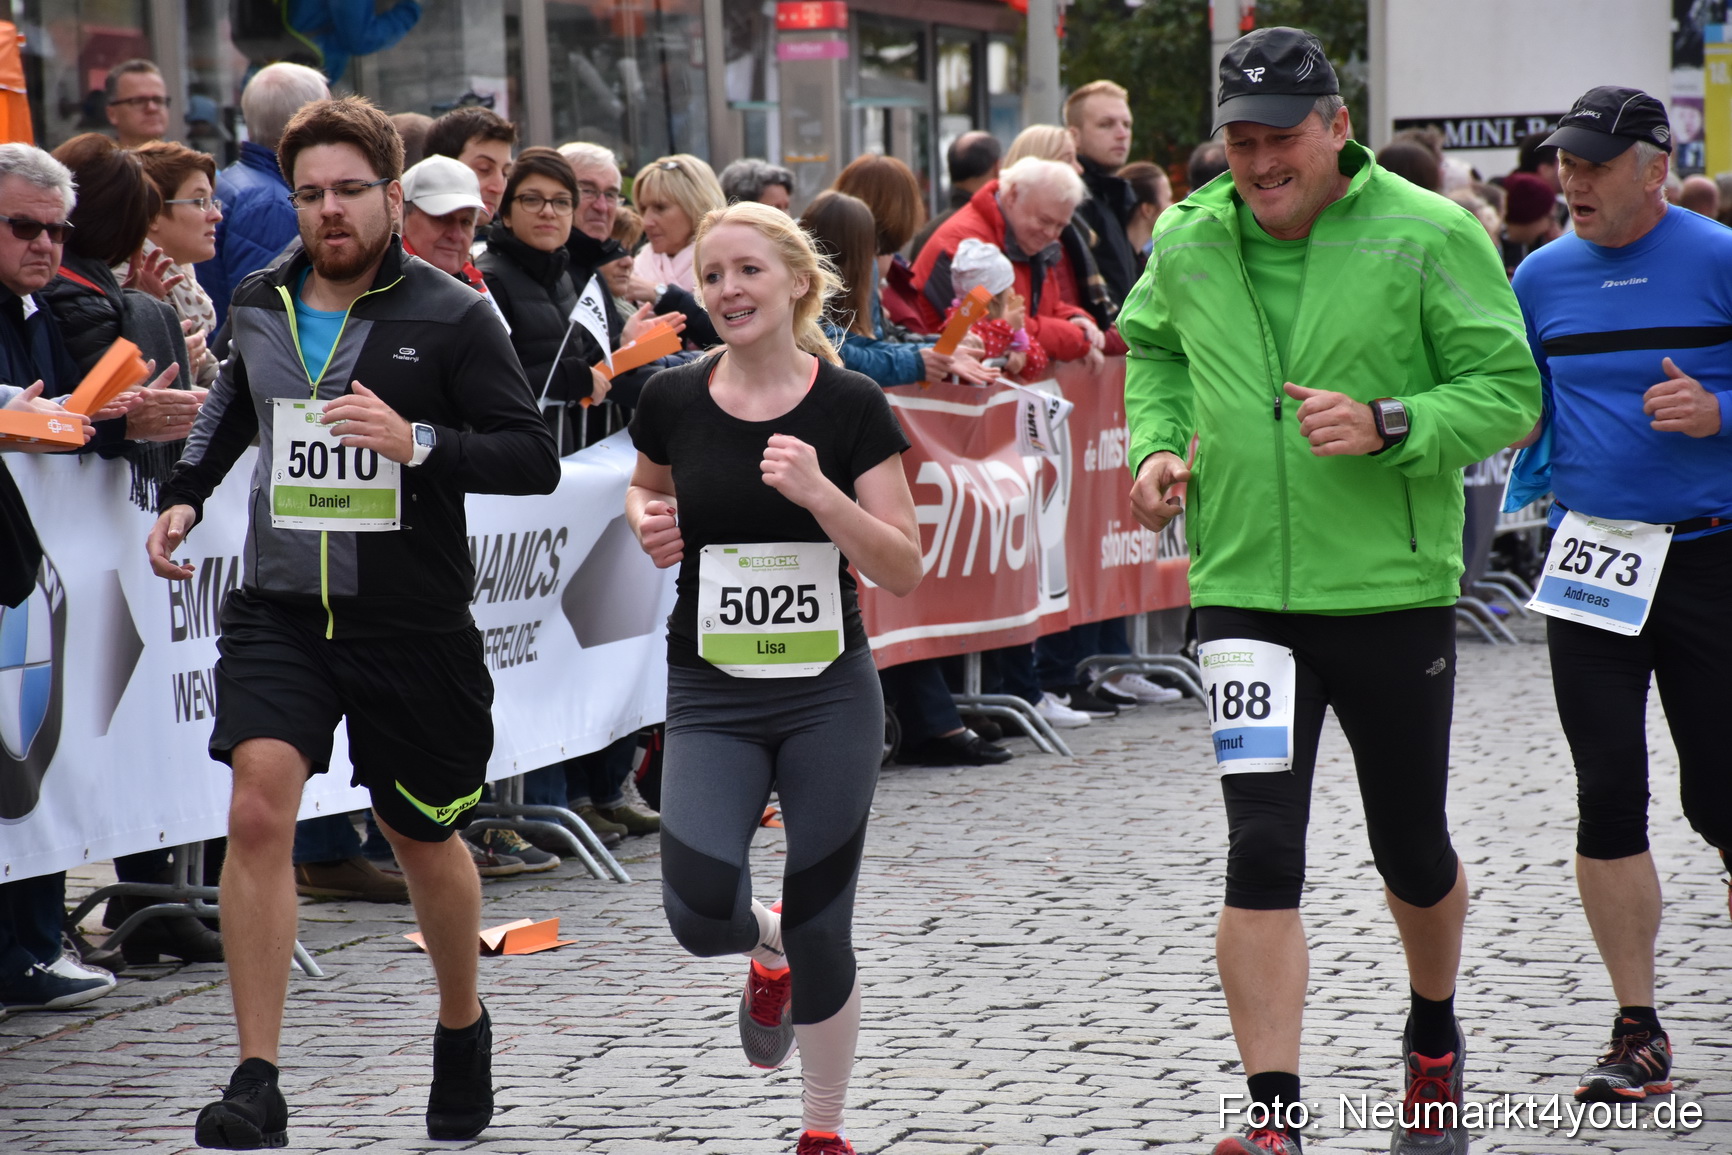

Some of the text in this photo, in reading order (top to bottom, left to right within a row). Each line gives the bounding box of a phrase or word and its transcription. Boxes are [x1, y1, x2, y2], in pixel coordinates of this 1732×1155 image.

[288, 440, 378, 481] 5010
[309, 493, 350, 509] Daniel
[751, 555, 799, 568] BOCK
[1558, 537, 1642, 587] 2573
[720, 584, 820, 626] 5025
[1563, 586, 1611, 608] Andreas
[757, 640, 787, 654] Lisa
[1210, 652, 1255, 666] BOCK
